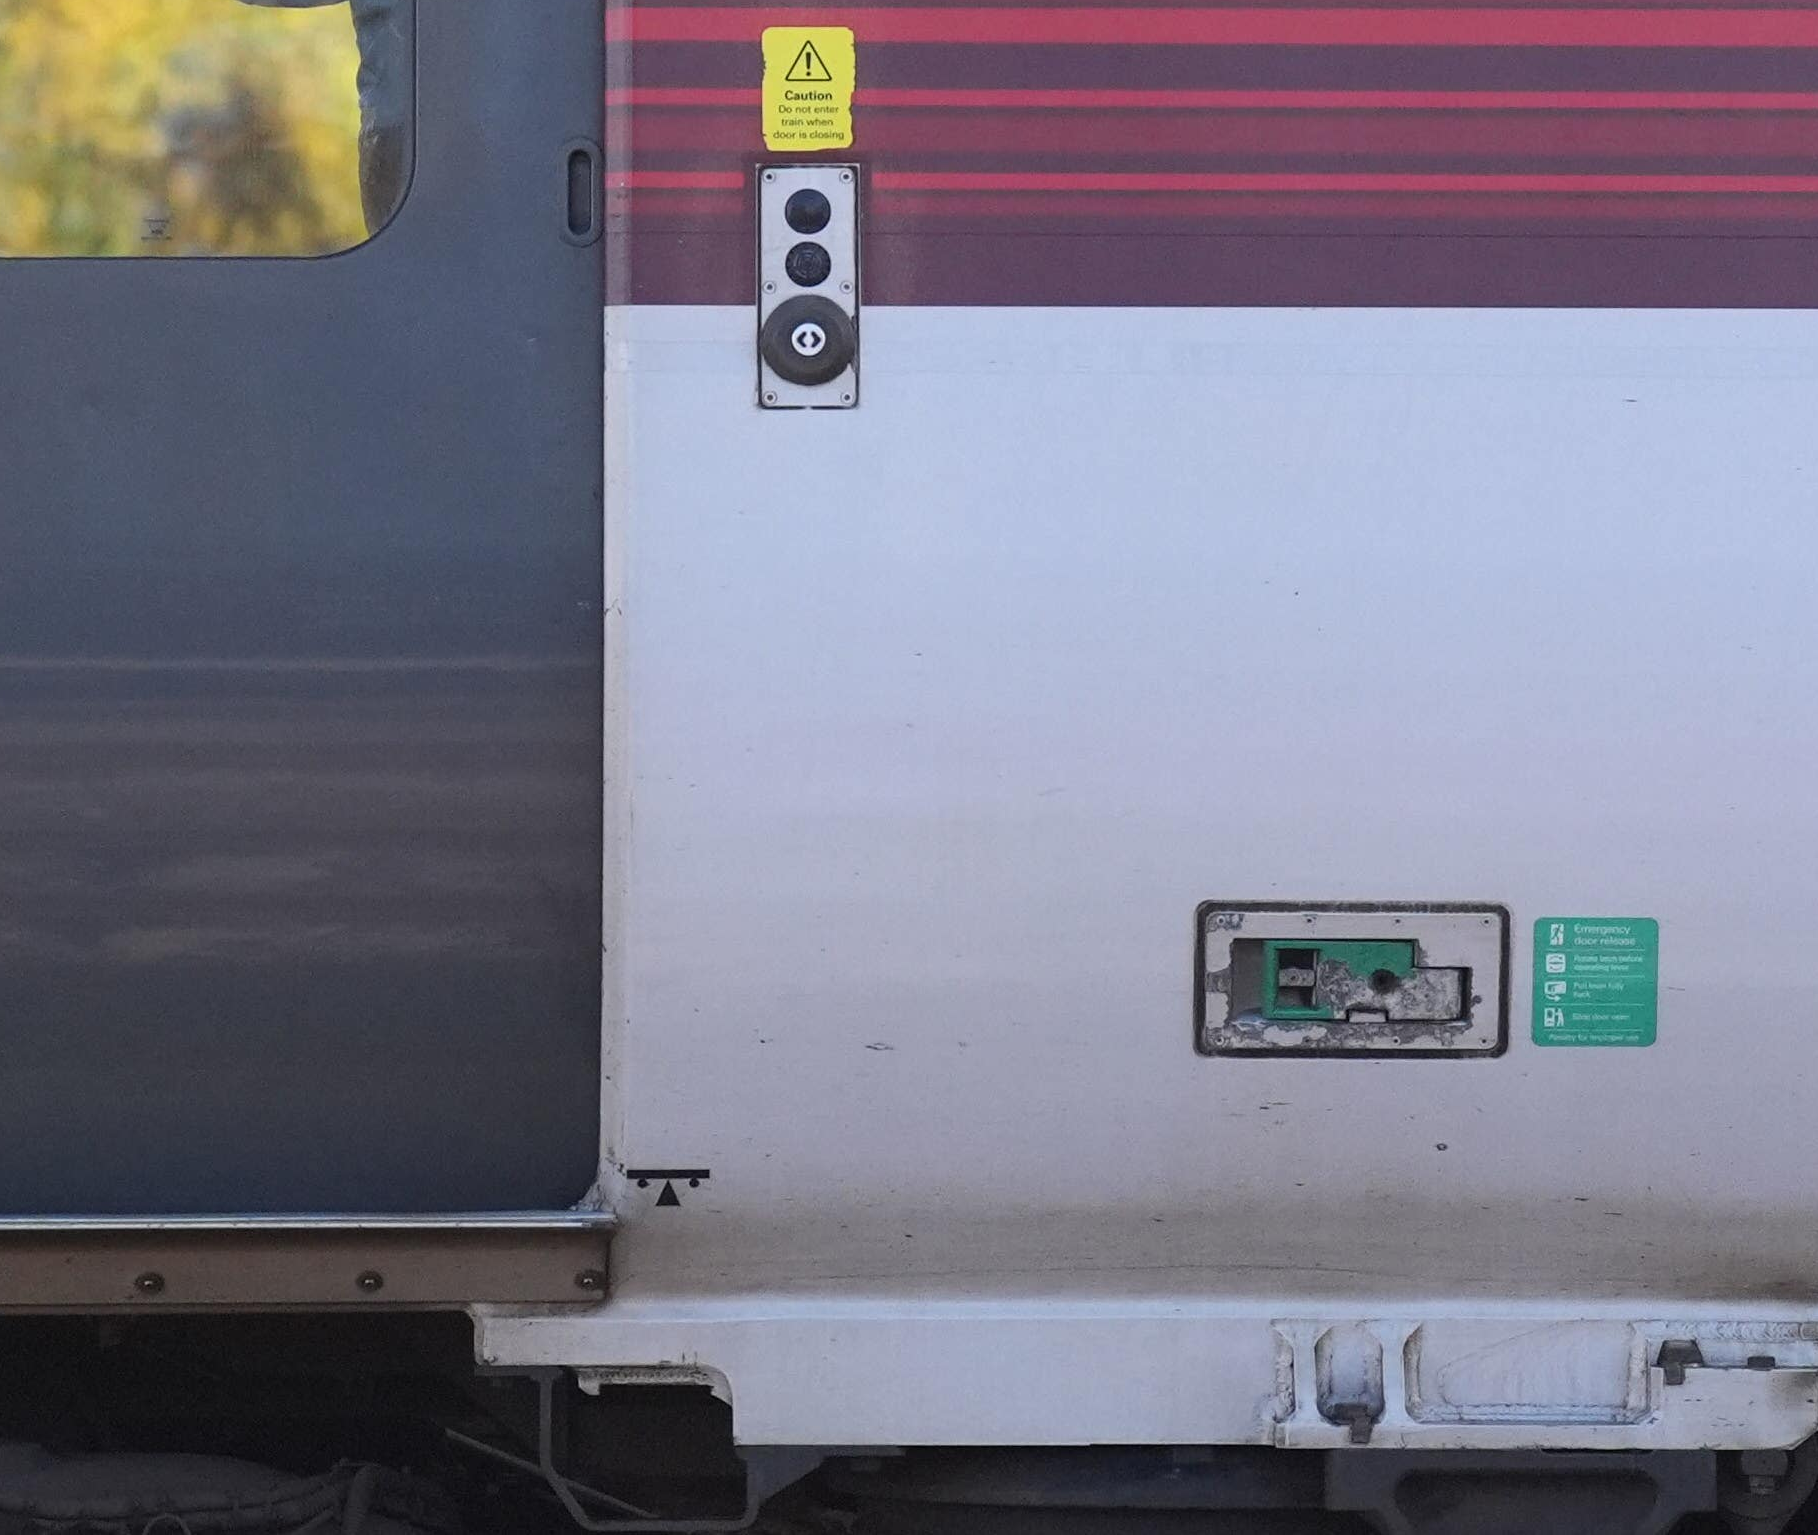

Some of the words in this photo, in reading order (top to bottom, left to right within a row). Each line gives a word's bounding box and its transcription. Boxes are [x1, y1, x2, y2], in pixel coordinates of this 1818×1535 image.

[784, 90, 833, 101] Caution
[778, 104, 793, 114] Do
[795, 106, 811, 114] not
[814, 106, 839, 114] enter
[781, 118, 804, 126] train
[806, 117, 834, 126] when
[773, 130, 797, 139] door
[799, 130, 807, 139] is
[809, 130, 845, 141] closing
[1574, 923, 1631, 935] Emergency
[1574, 936, 1598, 946] door
[1600, 936, 1637, 946] release
